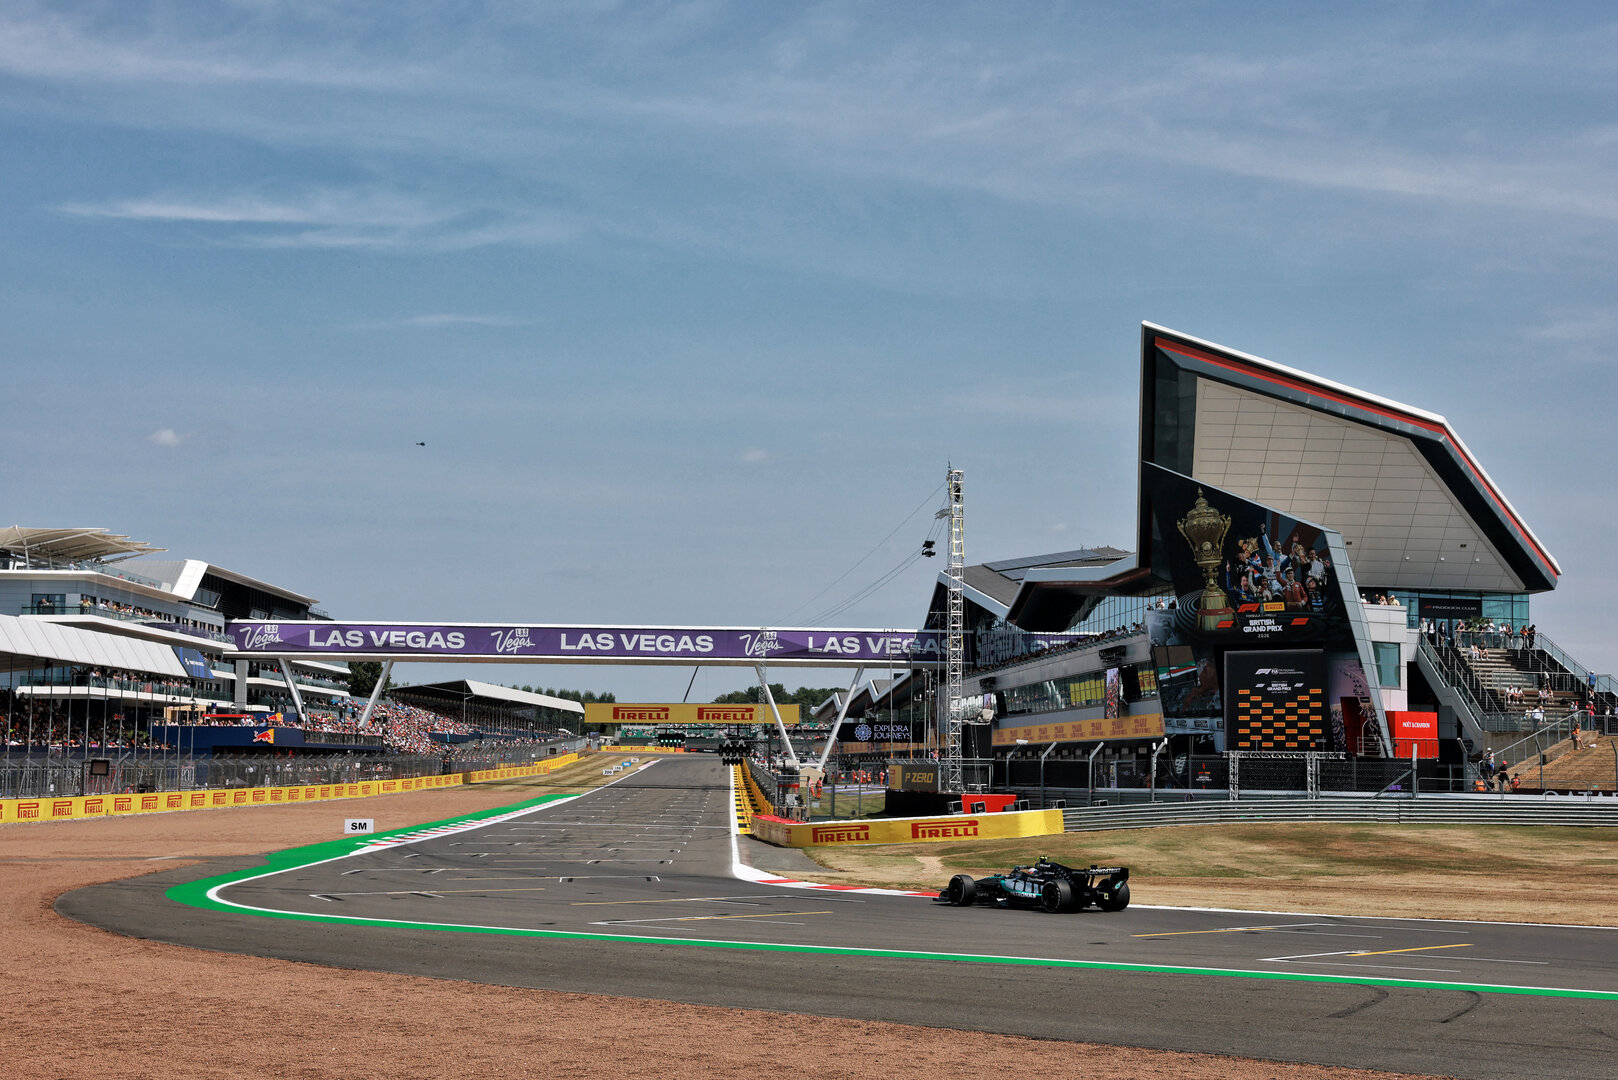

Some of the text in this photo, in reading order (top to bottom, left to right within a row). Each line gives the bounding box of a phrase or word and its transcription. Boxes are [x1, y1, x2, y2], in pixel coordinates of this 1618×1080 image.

[240, 626, 284, 650] Vegas
[309, 630, 466, 649] LAS VEGAS
[491, 630, 535, 654] Vegas
[560, 633, 714, 652] LAS VEGAS
[739, 634, 783, 657] Vegas
[808, 636, 861, 653] LAS
[612, 707, 754, 720] PIRELLI PIRELLI
[874, 732, 912, 740] JOURNEYS
[905, 772, 911, 782] P
[911, 772, 934, 783] ZERO
[18, 803, 39, 819] PIRELLI
[53, 801, 72, 816] PIRELLI
[85, 799, 103, 814] PIRELLI
[114, 797, 132, 811] PIRELLI
[142, 796, 158, 810] PIRELLI
[167, 795, 182, 808] PIRELLI
[351, 822, 367, 830] SM
[812, 825, 869, 843] PIRELLI
[911, 820, 979, 839] PIRELLI
